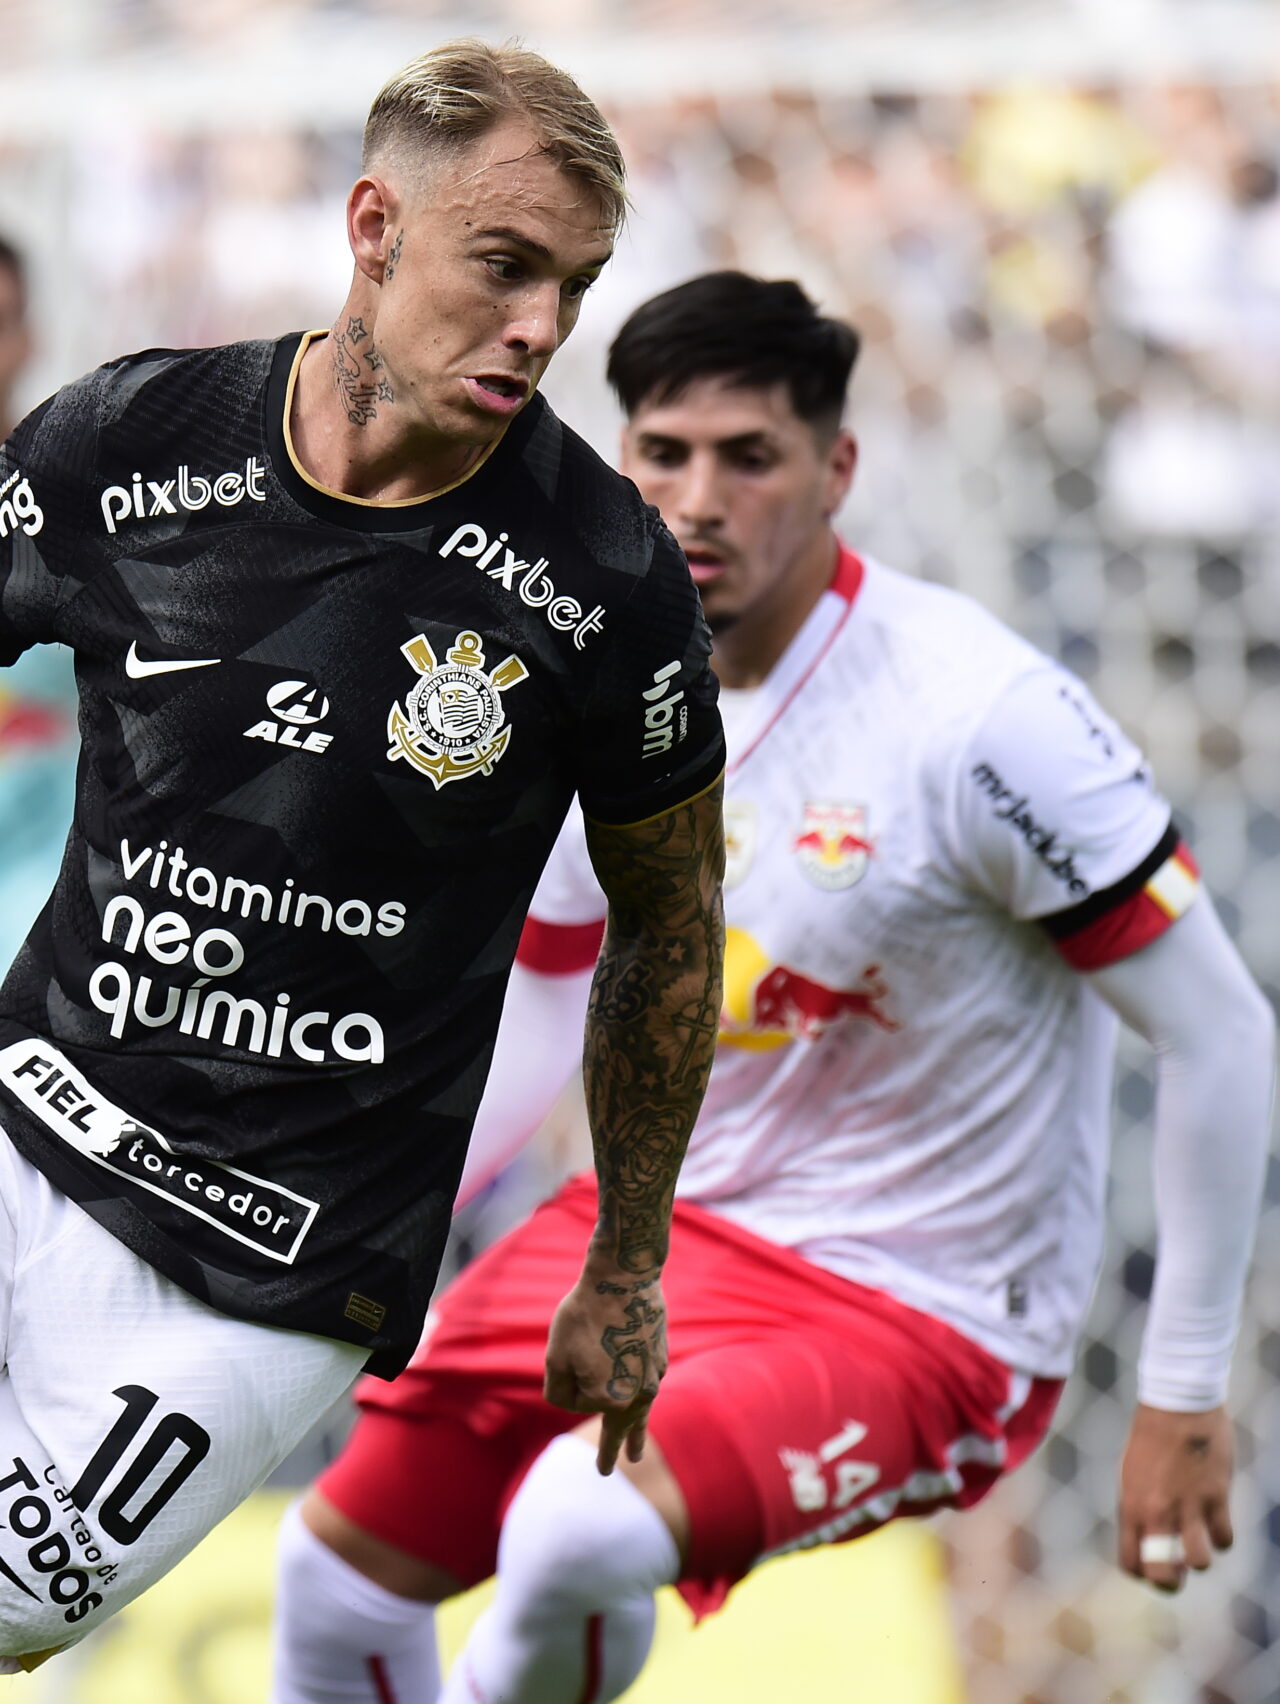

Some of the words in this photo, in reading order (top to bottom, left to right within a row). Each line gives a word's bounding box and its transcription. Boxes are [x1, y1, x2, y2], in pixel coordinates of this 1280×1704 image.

[100, 457, 266, 533] pixbet
[438, 523, 606, 650] pixbet
[242, 720, 334, 754] ALE
[418, 673, 482, 708] CORINTHIANS
[472, 689, 493, 739] PAULISTA
[438, 736, 463, 747] 1910
[120, 838, 407, 937] vitaminas
[102, 895, 244, 977] neo
[88, 961, 385, 1064] química
[12, 1054, 99, 1134] FIEL
[127, 1138, 290, 1235] torcedor
[69, 1384, 211, 1546] 10
[818, 1418, 881, 1509] 14
